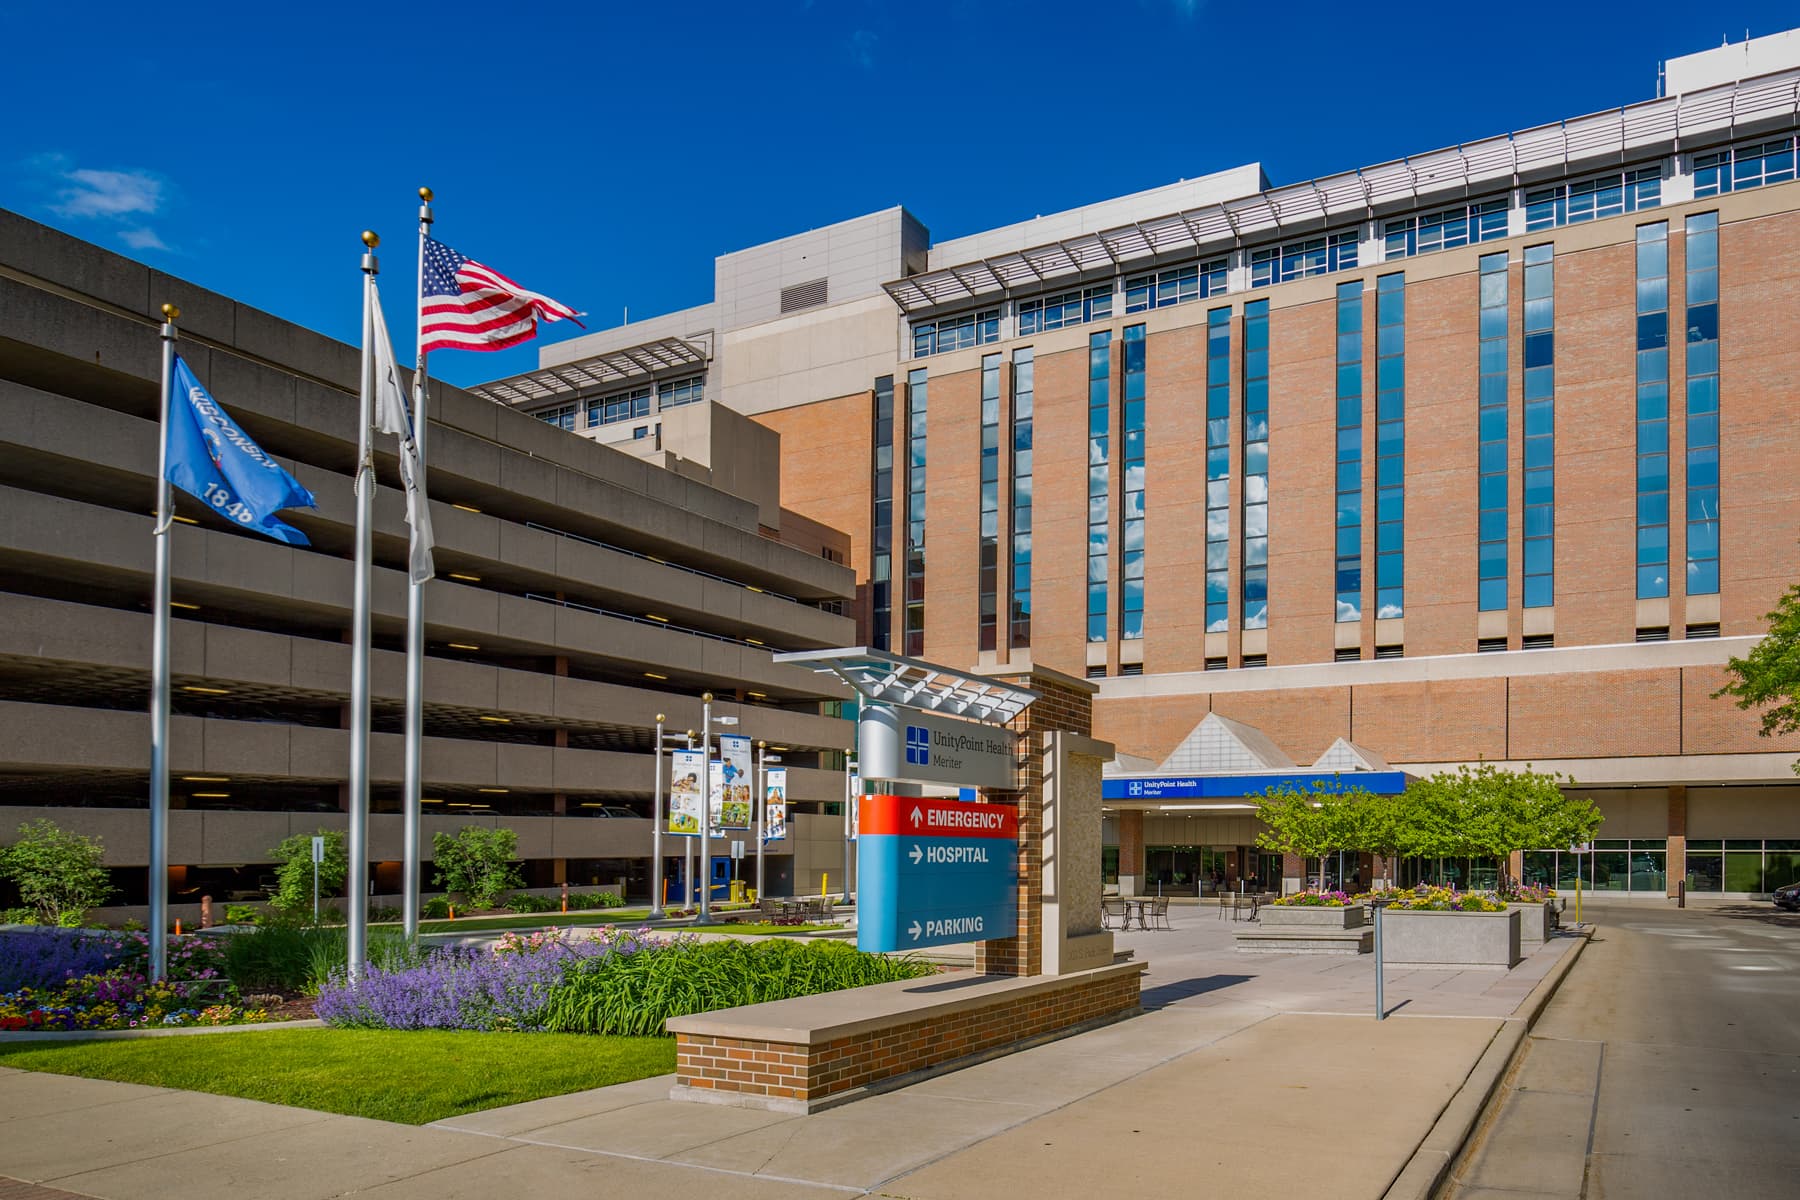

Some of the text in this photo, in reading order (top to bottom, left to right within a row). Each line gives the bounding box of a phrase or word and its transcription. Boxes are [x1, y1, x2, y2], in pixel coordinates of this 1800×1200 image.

[189, 387, 278, 468] WISCONSIN
[933, 730, 1014, 757] UnityPoint Health
[933, 754, 962, 769] Meriter
[1144, 781, 1176, 789] UnityPoint
[927, 809, 1004, 829] EMERGENCY
[927, 846, 989, 863] HOSPITAL
[926, 916, 984, 937] PARKING
